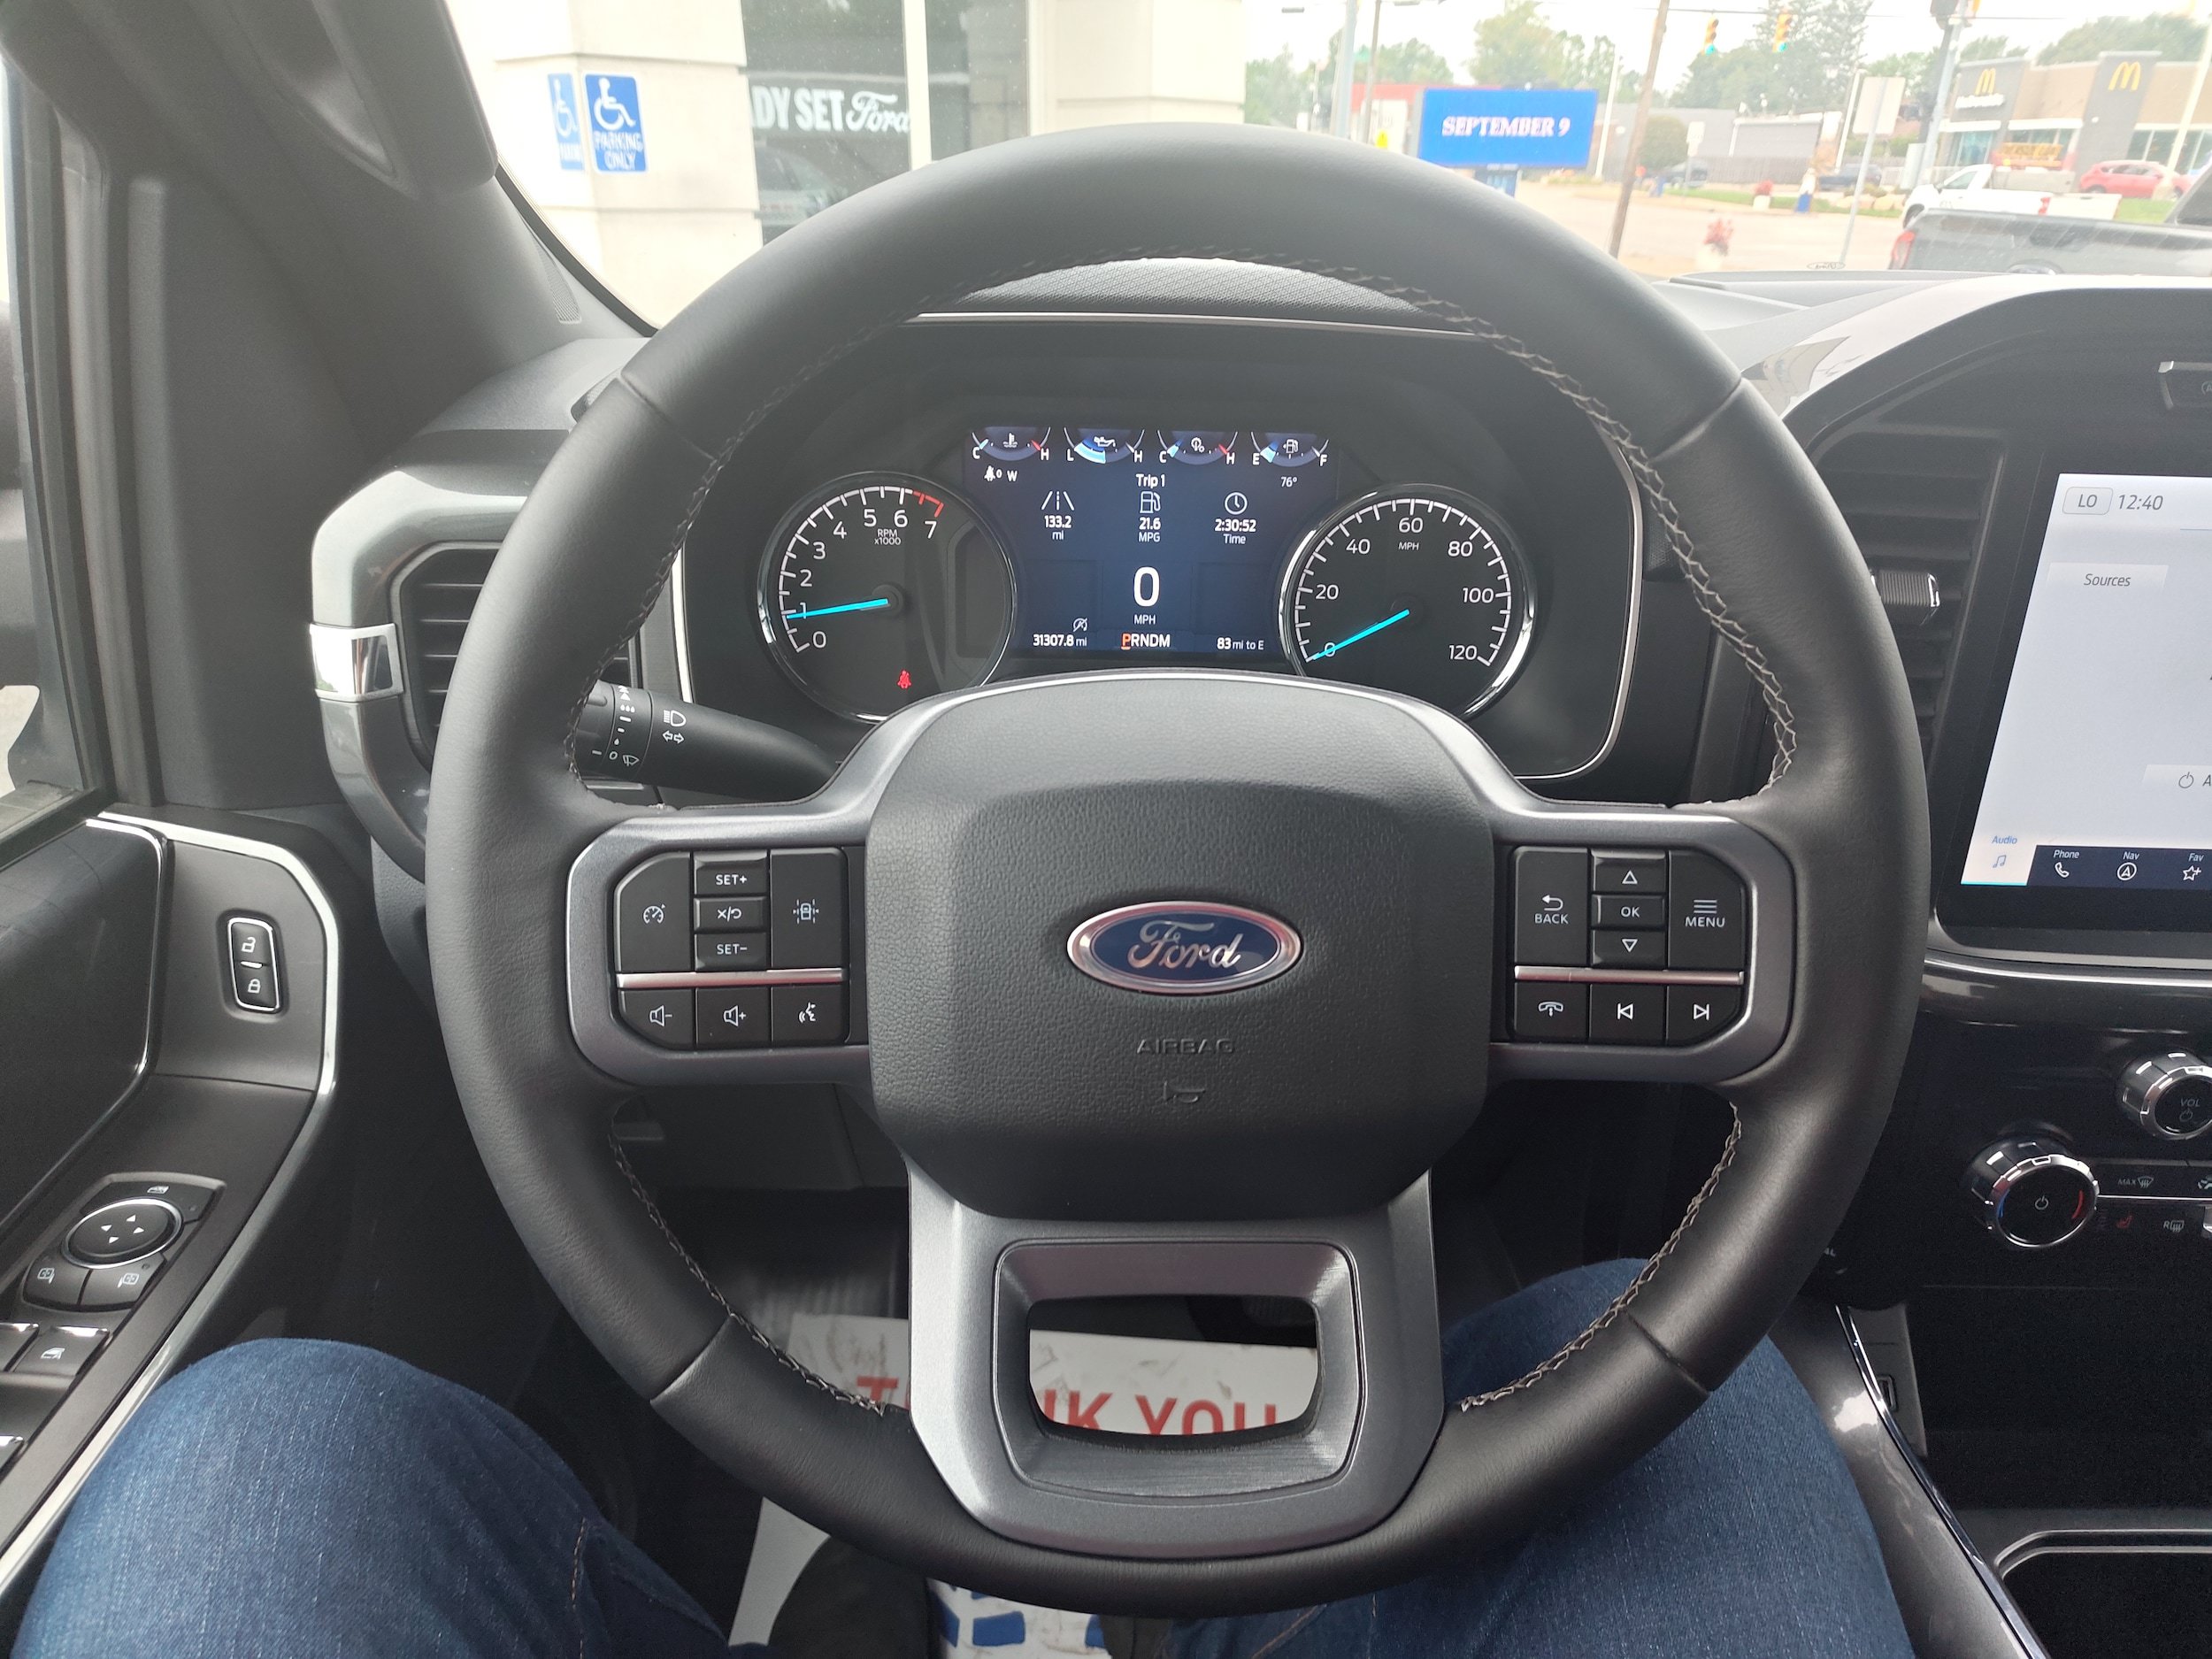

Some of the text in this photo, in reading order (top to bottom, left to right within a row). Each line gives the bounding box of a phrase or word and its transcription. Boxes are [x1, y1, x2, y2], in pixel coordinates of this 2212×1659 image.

[794, 88, 845, 132] SET
[1441, 116, 1571, 138] SEPTEMBER 9
[593, 131, 645, 152] PARKING
[604, 150, 636, 170] ONLY
[972, 447, 981, 460] C
[1041, 449, 1050, 461] H
[1067, 449, 1074, 462] L
[1134, 450, 1143, 463] H
[1159, 450, 1168, 464] C
[1226, 452, 1235, 465] H
[1253, 452, 1261, 465] E
[1320, 454, 1328, 466] F
[1007, 471, 1018, 482] W
[1136, 473, 1165, 488] Trip 1
[2078, 494, 2163, 511] LO 12:40
[864, 509, 877, 527] 5
[894, 510, 908, 528] 6
[1044, 515, 1072, 529] 133.2
[1139, 518, 1162, 531] 21.6
[833, 521, 847, 540] 4
[925, 520, 937, 540] 7
[1215, 519, 1257, 533] 2:30:52
[1398, 518, 1424, 534] 60
[878, 529, 898, 538] RPM
[1052, 531, 1064, 541] mi
[1139, 532, 1161, 544] MPG
[1224, 534, 1247, 545] Time
[874, 537, 901, 546] x1000
[1346, 538, 1371, 556] 40
[1398, 541, 1419, 551] MPH
[813, 541, 826, 560] 3
[1448, 541, 1473, 557] 80
[800, 569, 812, 588] 2
[2083, 573, 2131, 588] Sources
[1133, 566, 1161, 608] 0
[1315, 585, 1340, 601] 20
[1462, 588, 1494, 604] 100
[1134, 615, 1156, 626] MPH
[812, 631, 827, 649] 0
[1033, 634, 1087, 648] 31307.8 mi
[1121, 634, 1171, 650] PRNDM
[1217, 638, 1264, 650] 83 mi to E
[1324, 641, 1336, 657] 0
[1448, 645, 1478, 662] 120
[1991, 835, 2017, 845] Audio
[2053, 849, 2079, 859] Phone
[2123, 851, 2140, 861] Nav
[2188, 852, 2205, 863] Fav
[715, 874, 748, 886] SET+
[1534, 913, 1569, 925] BACK
[1620, 906, 1640, 918] OK
[1685, 917, 1725, 928] MENU
[1126, 919, 1243, 969] Ford
[1136, 1038, 1236, 1056] AIRBAG
[2180, 1098, 2200, 1107] VOL
